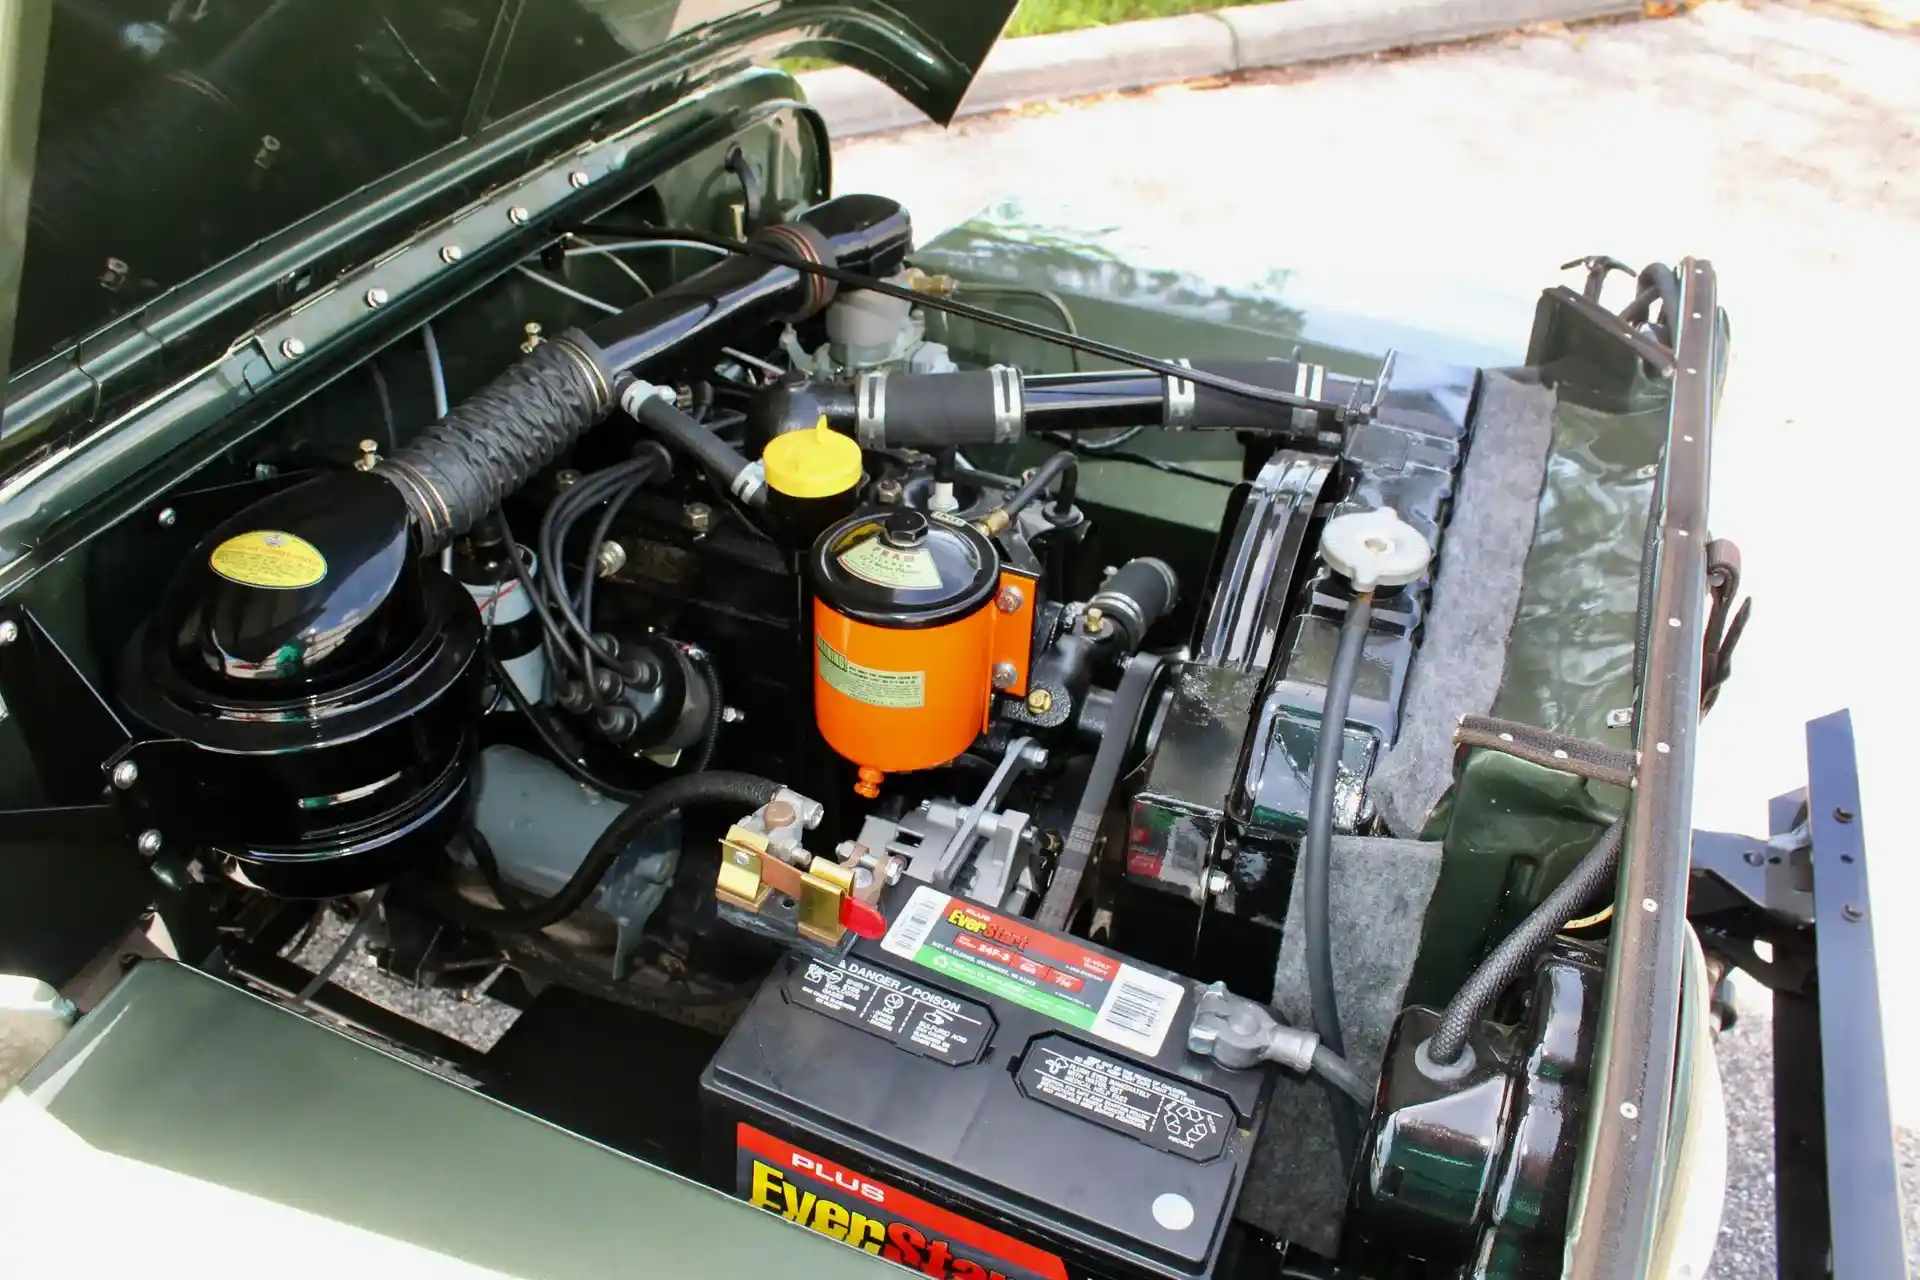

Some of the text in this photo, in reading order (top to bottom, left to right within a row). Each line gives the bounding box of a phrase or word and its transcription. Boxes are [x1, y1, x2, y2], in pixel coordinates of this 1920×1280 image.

[947, 908, 1029, 952] EverStart
[848, 963, 901, 990] DANGER
[911, 988, 961, 1013] POISON
[792, 1153, 884, 1202] PLUS
